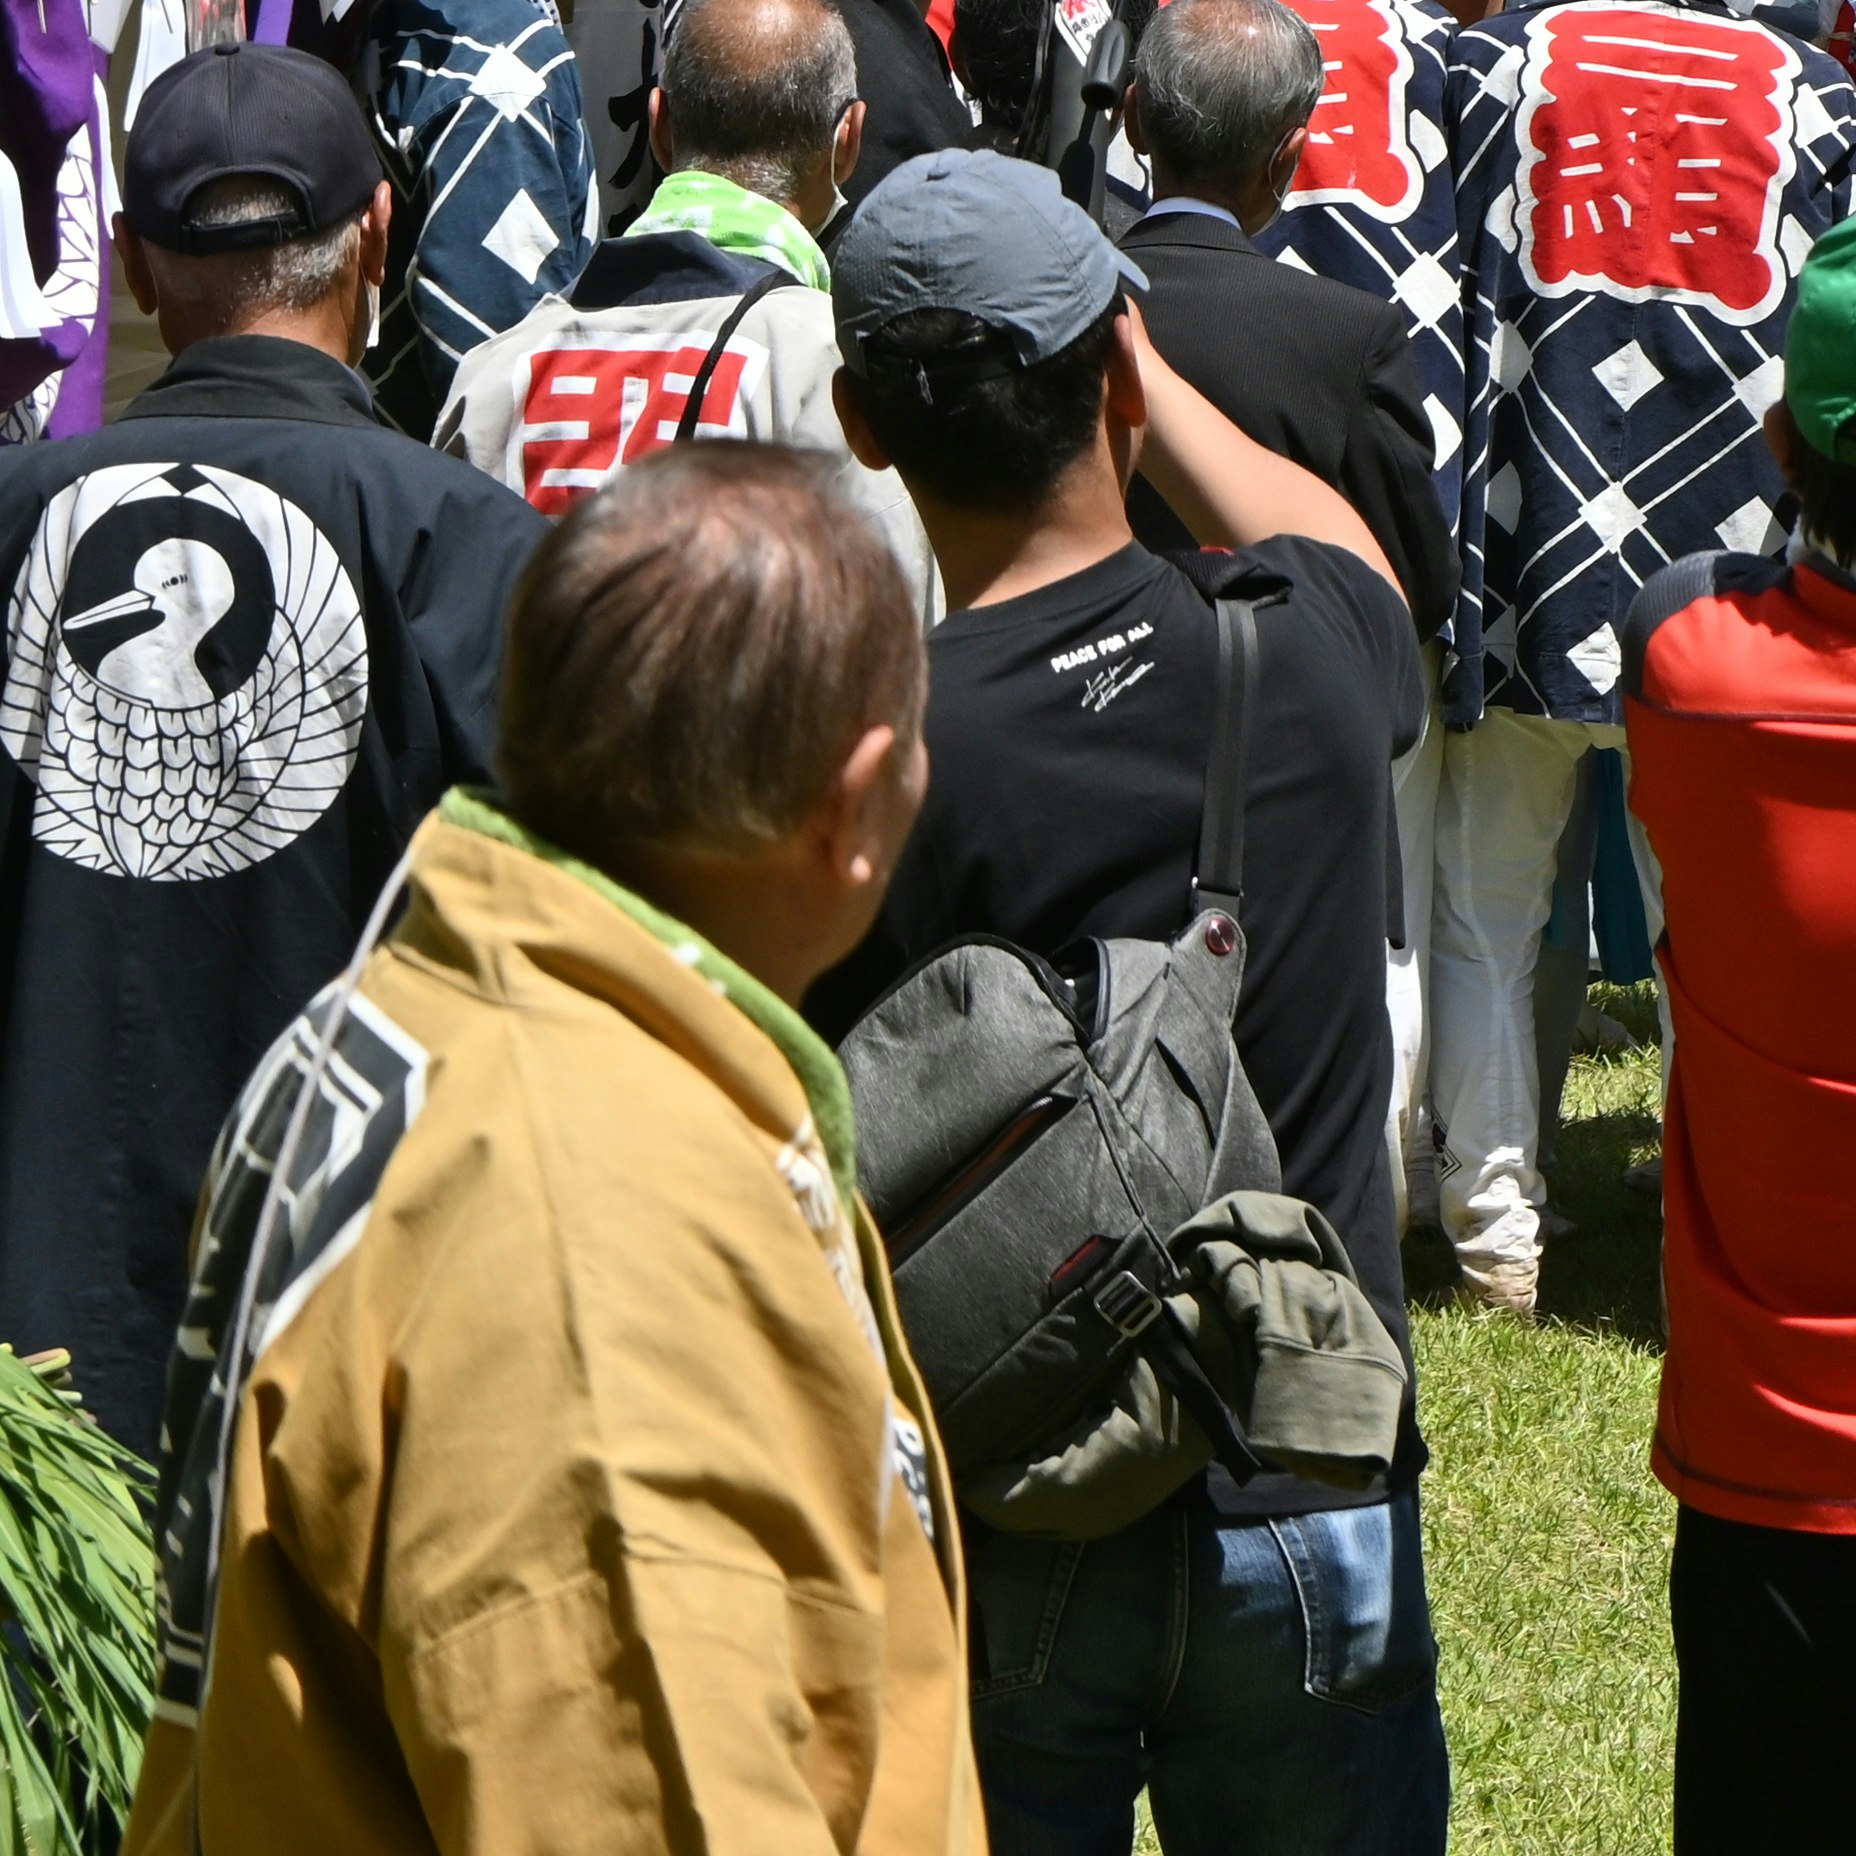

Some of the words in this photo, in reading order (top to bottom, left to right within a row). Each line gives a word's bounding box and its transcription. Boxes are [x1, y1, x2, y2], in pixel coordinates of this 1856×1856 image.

[1050, 644, 1098, 673] PEACE
[1097, 634, 1126, 656] FOR
[1127, 621, 1154, 643] ALL
